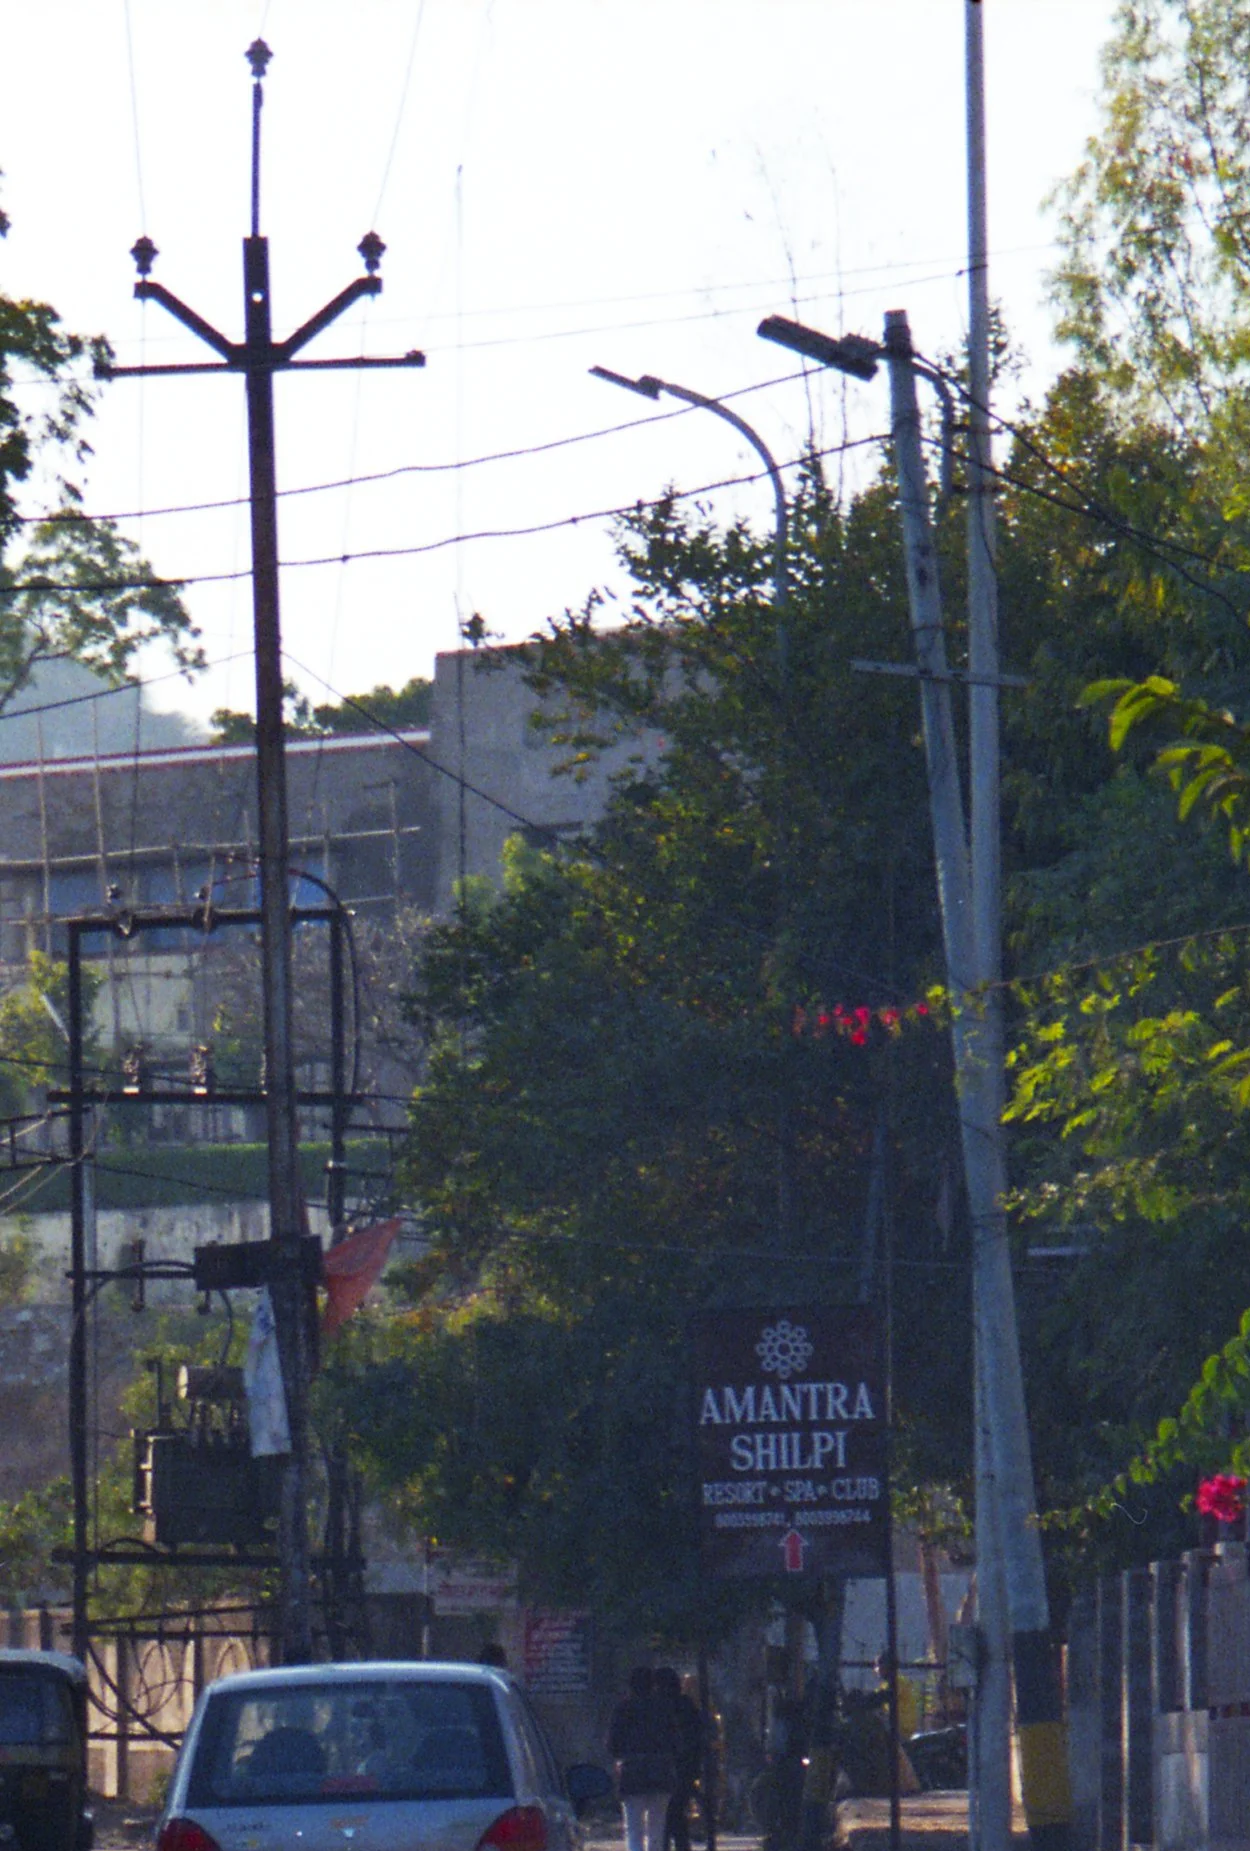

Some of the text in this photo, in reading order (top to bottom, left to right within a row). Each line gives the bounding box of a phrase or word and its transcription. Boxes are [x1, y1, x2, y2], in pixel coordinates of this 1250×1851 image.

[700, 1381, 876, 1425] AMANTRA
[730, 1429, 847, 1470] SHILPI
[703, 1477, 880, 1505] RESORT SPA CLUB
